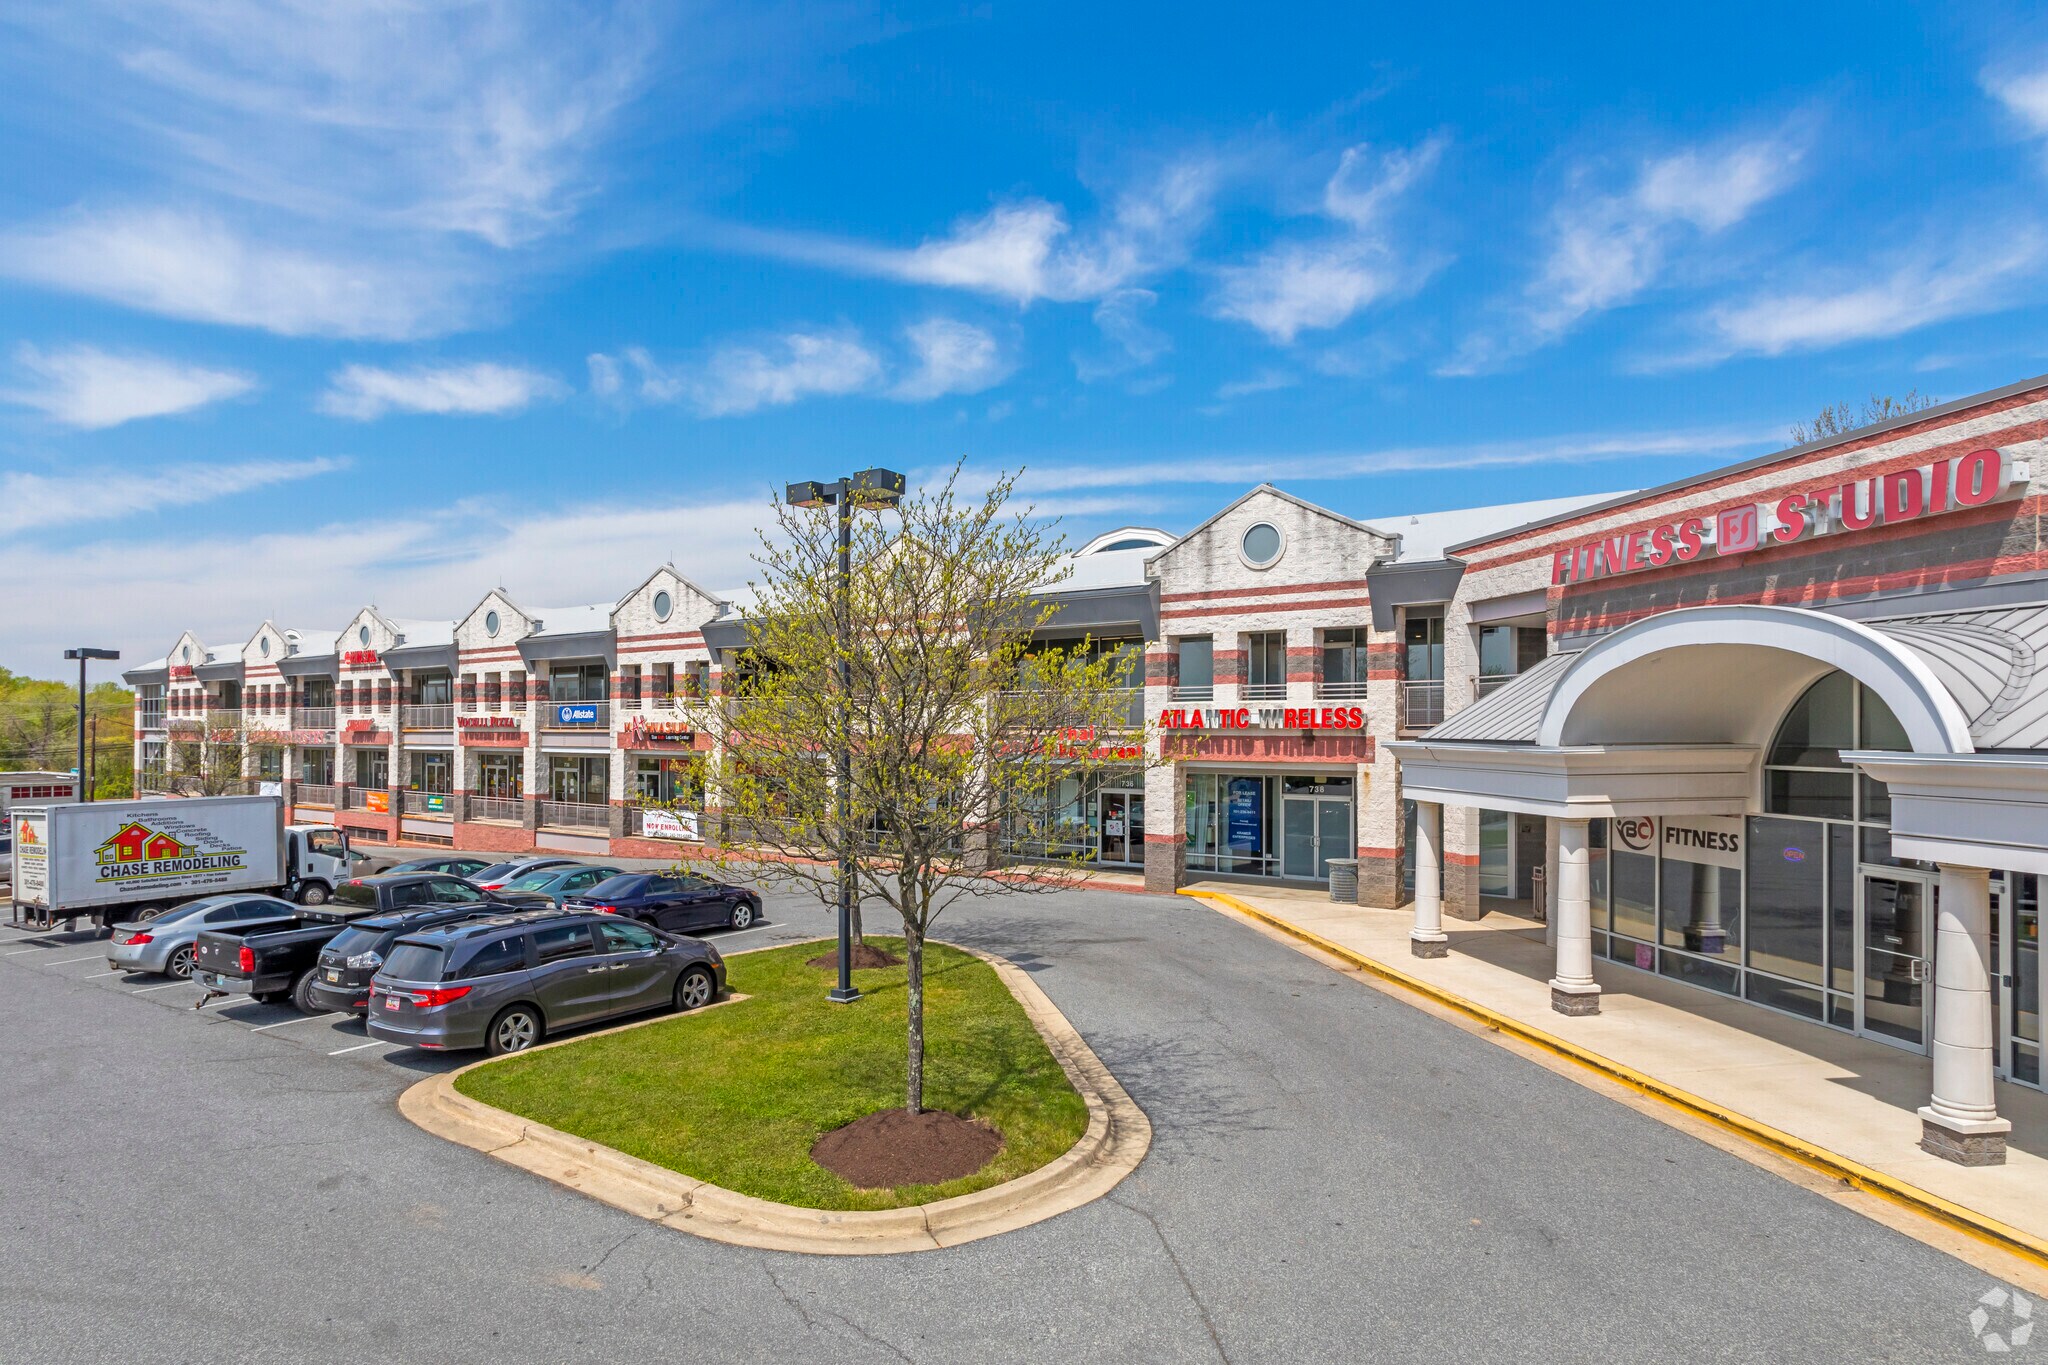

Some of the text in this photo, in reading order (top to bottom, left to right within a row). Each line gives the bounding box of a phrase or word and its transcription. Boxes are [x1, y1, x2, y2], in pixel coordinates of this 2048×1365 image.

[1551, 517, 1704, 585] FITNESS
[1772, 448, 2002, 544] STUDIO
[490, 715, 515, 729] PIZZA
[572, 709, 594, 720] Allstate
[1158, 707, 1364, 729] ATLANTIC WIRELESS
[1056, 725, 1095, 741] Thai
[1058, 743, 1143, 759] Reauant
[1308, 785, 1325, 793] 738
[646, 822, 694, 832] NOW ENROLLG
[1665, 826, 1739, 852] FITNESS
[1783, 849, 1805, 860] OPEN
[100, 855, 241, 878] CHASE REMODELING
[119, 881, 182, 893] ChaseRemodeling.com
